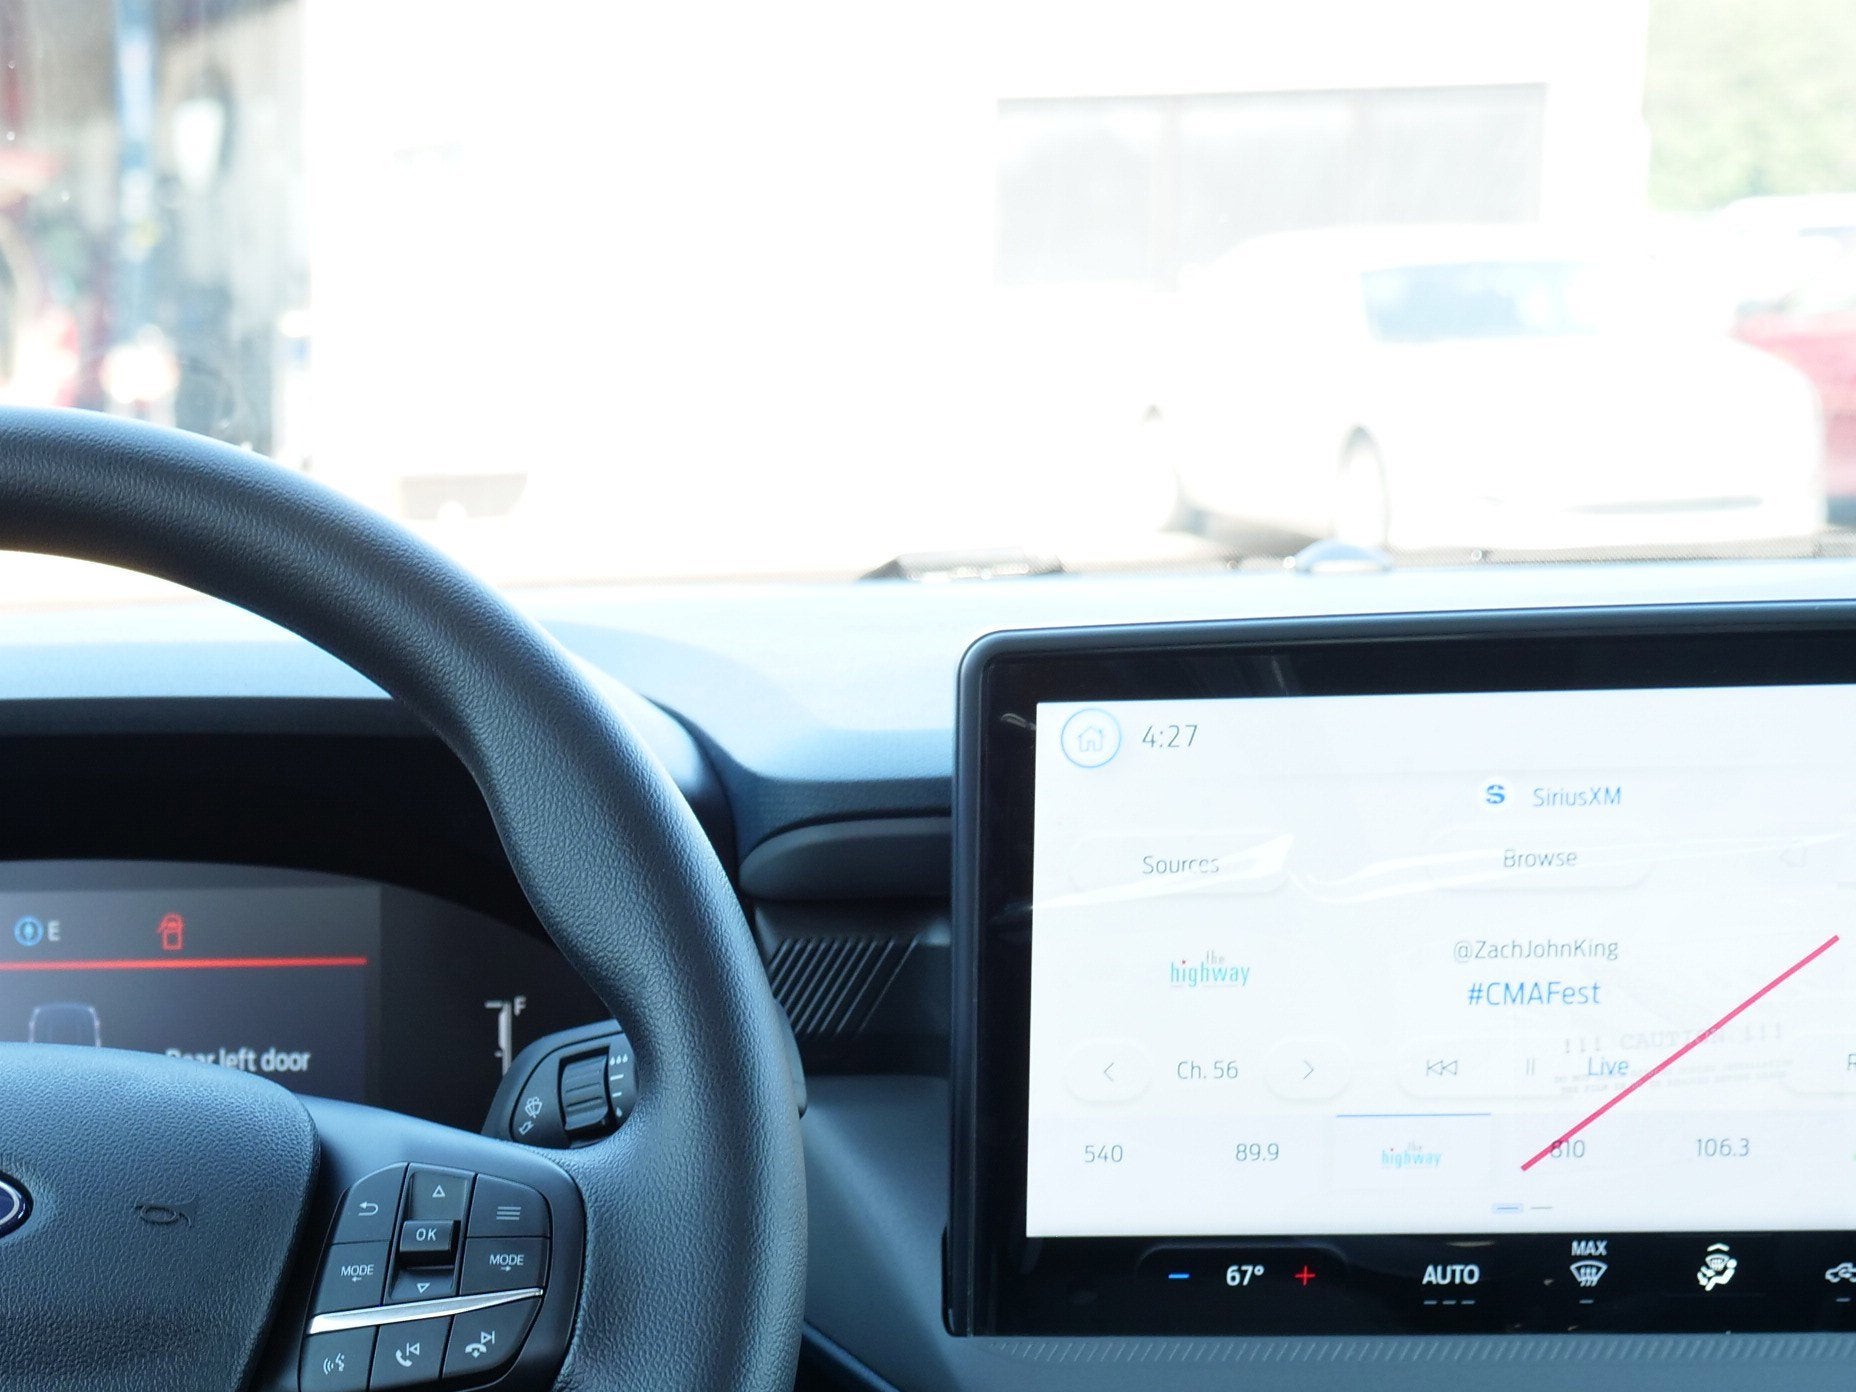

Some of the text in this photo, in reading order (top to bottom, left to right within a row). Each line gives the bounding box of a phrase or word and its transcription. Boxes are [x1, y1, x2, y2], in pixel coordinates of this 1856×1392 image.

[1141, 724, 1199, 749] 4:27
[1532, 785, 1623, 807] SiriusXM
[1502, 848, 1578, 868] Browse
[1453, 937, 1619, 964] @ZachJohnKing
[1170, 959, 1250, 988] highway
[1467, 980, 1602, 1006] #CMAFest
[260, 1046, 312, 1072] door
[1177, 1059, 1239, 1080] Ch. 56
[1587, 1056, 1630, 1077] Live
[1083, 1144, 1124, 1164] 540
[1234, 1142, 1280, 1162] 89.9
[1696, 1137, 1751, 1158] 106.3
[415, 1228, 437, 1242] OK
[1570, 1239, 1608, 1257] MAX
[341, 1264, 374, 1277] MODE
[489, 1254, 524, 1267] MODE
[1225, 1264, 1266, 1287] 67°
[1421, 1263, 1481, 1286] AUTO
